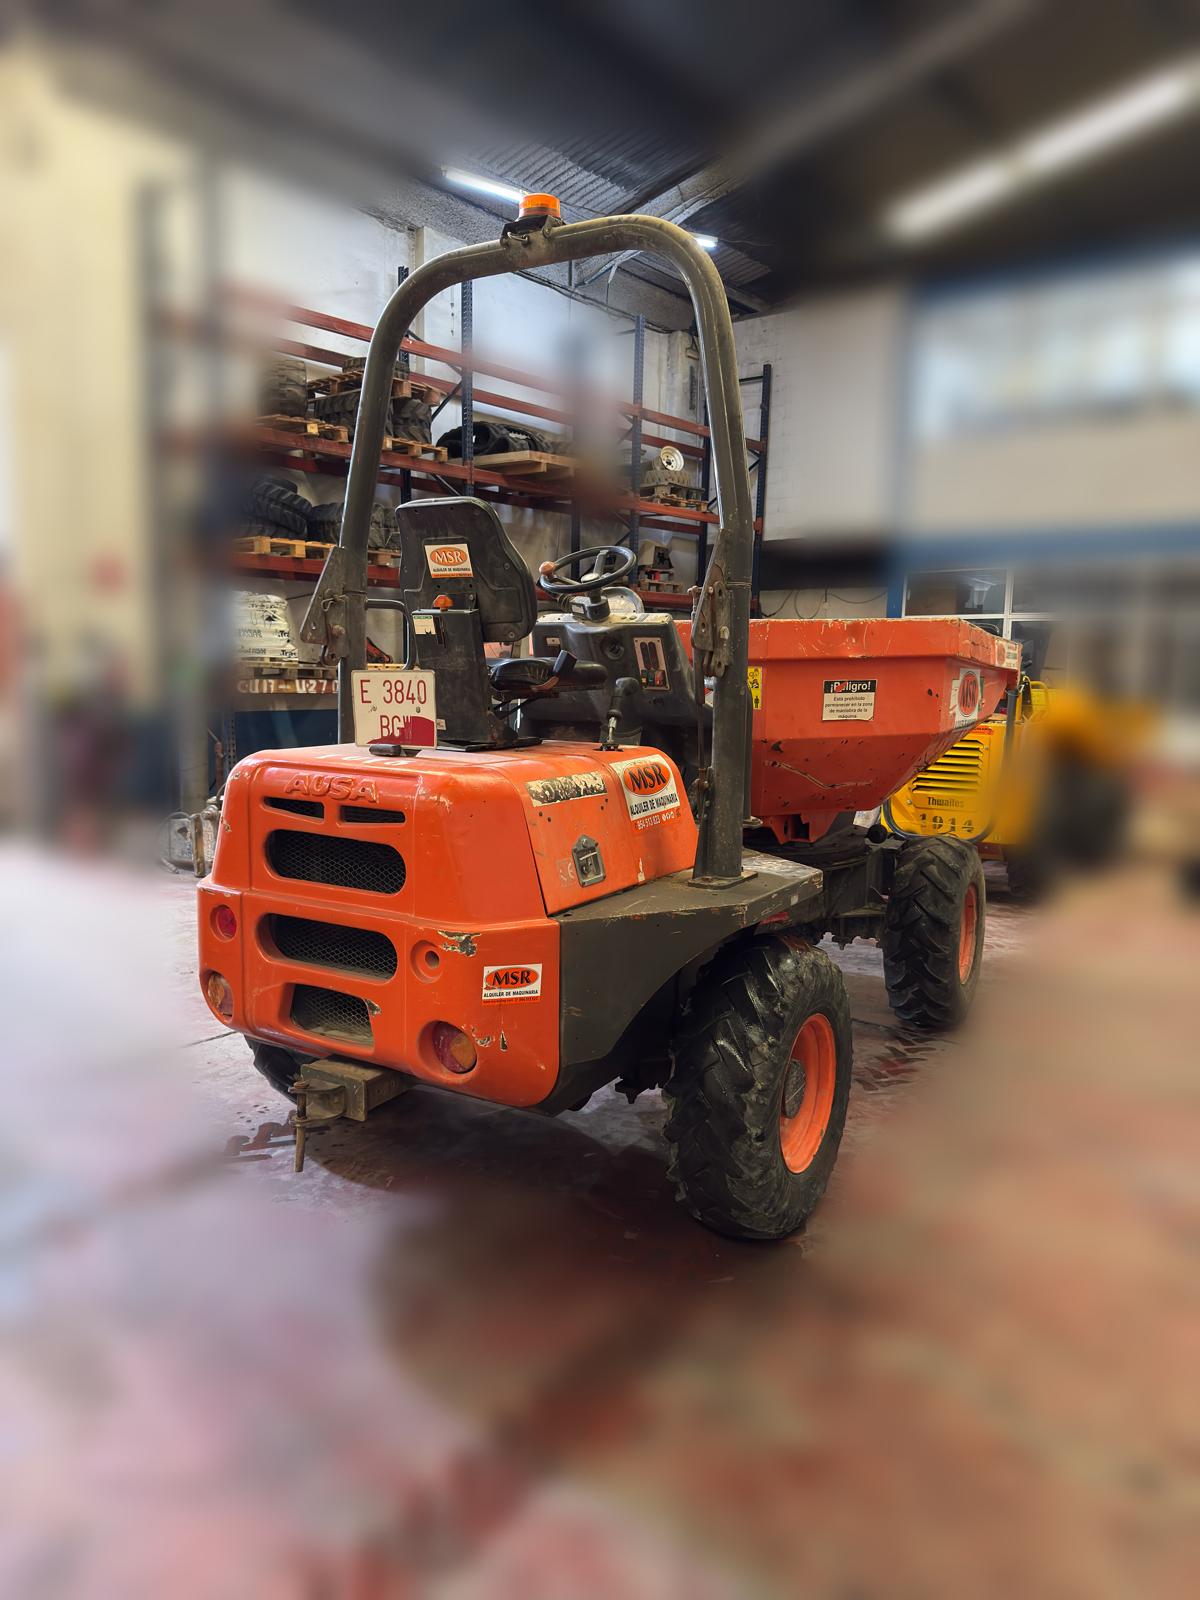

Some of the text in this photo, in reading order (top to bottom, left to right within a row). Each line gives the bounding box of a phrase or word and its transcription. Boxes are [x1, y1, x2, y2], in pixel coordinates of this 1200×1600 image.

[434, 550, 464, 563] MSR
[360, 679, 427, 705] E 3840
[830, 681, 871, 693] ¡Pligro!
[629, 765, 666, 791] MSR
[284, 773, 378, 803] AUSA
[630, 801, 649, 816] ALQUILER
[649, 799, 656, 811] DE
[492, 970, 532, 986] MSR
